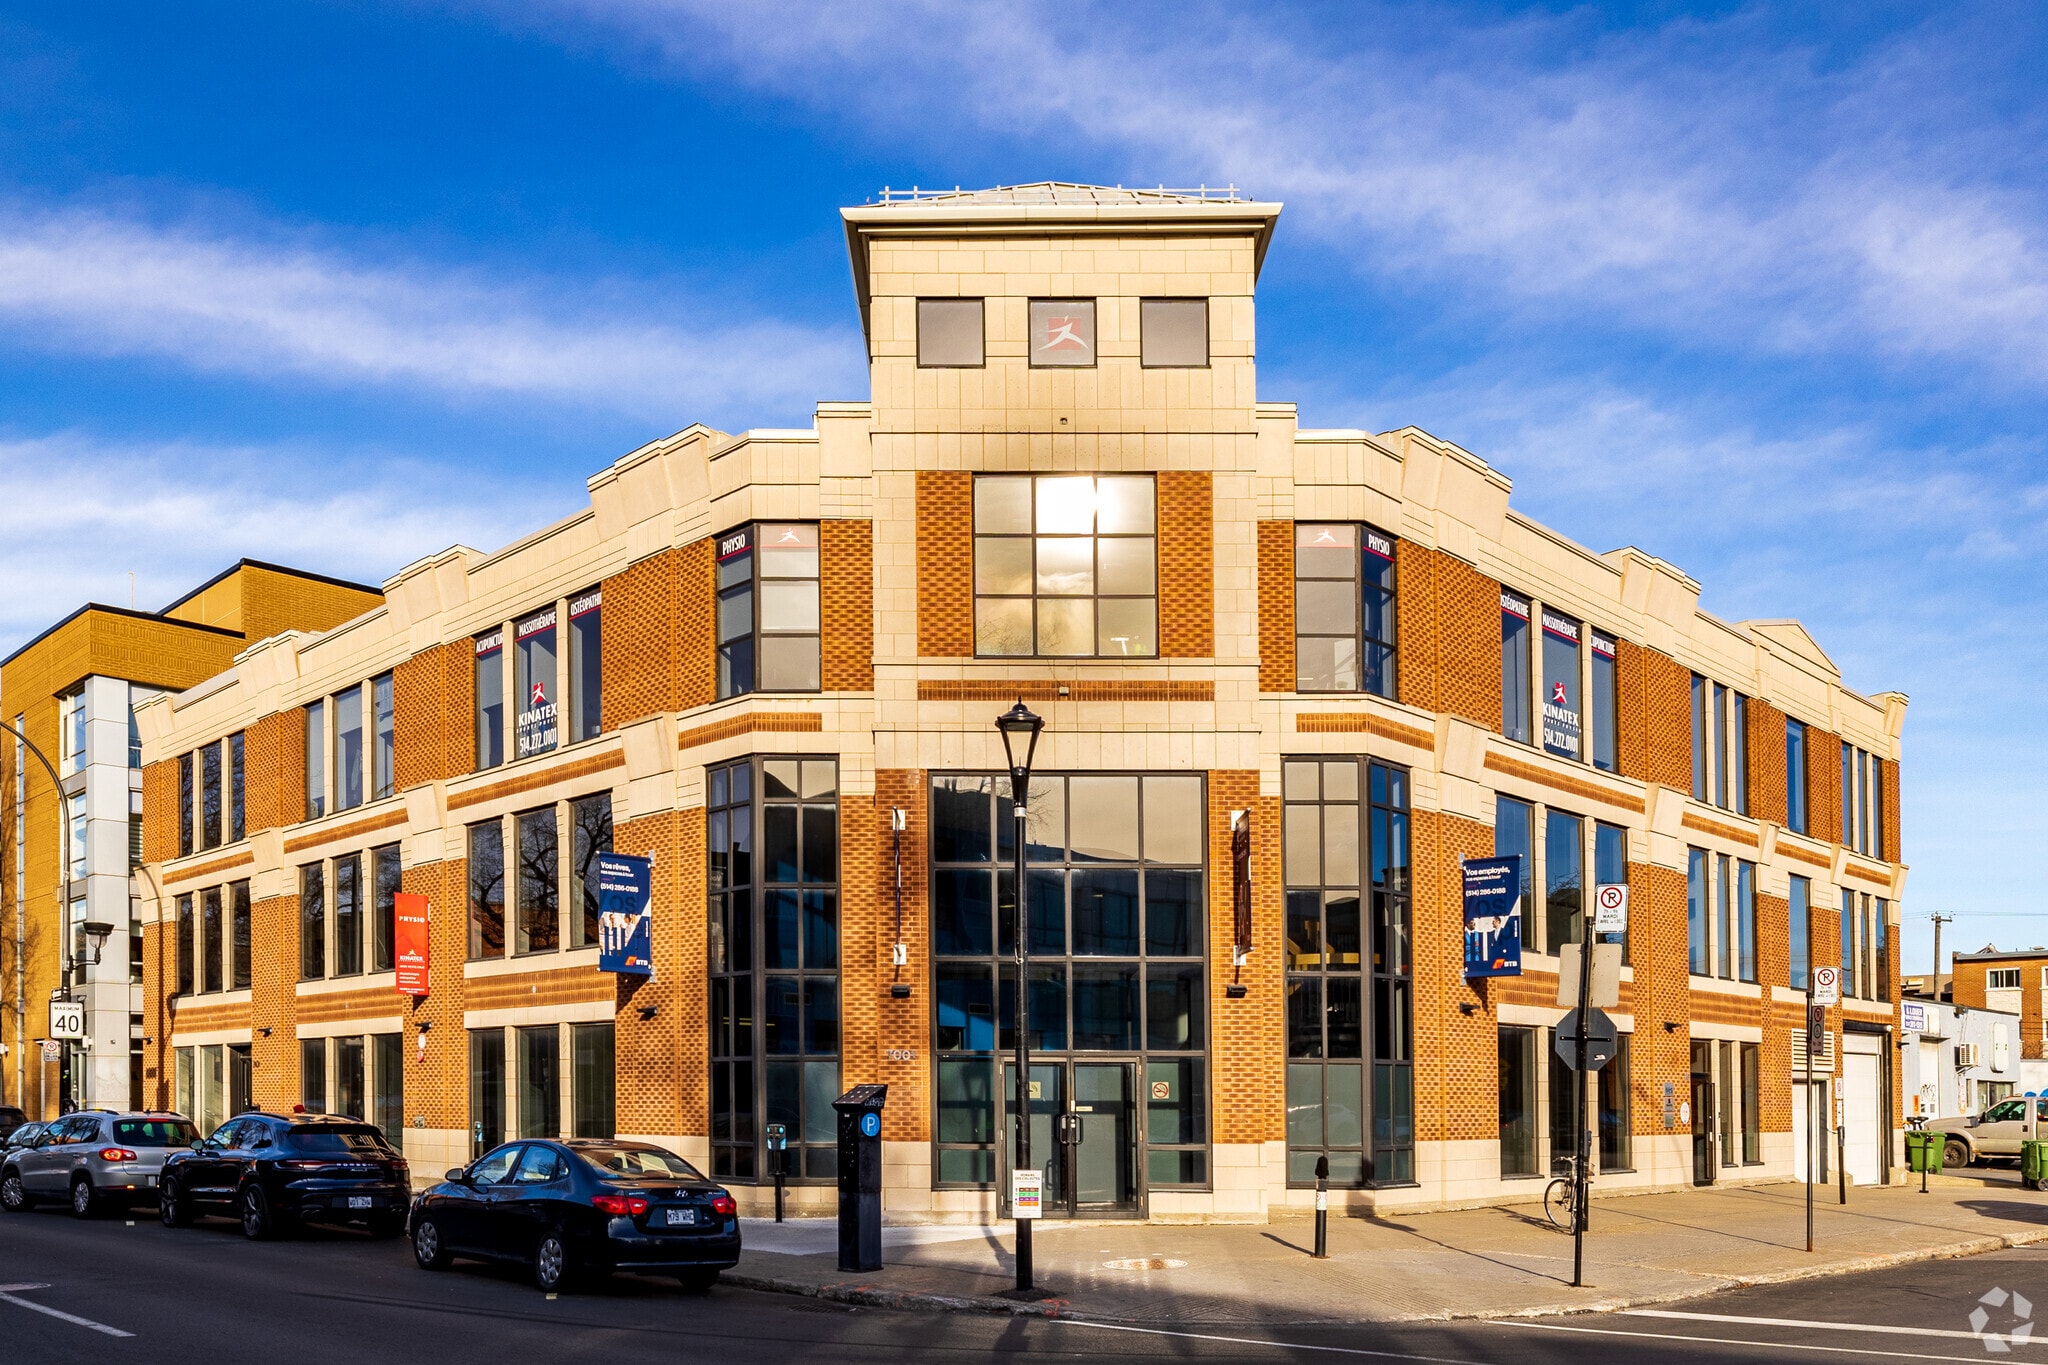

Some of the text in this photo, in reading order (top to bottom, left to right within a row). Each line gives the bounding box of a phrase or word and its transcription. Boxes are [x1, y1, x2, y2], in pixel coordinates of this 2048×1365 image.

[722, 534, 746, 556] PHYSIO
[1368, 534, 1390, 556] PHYSIO
[518, 611, 556, 637] MASSOTHÉRAPIE
[1542, 612, 1577, 638] MASSOTHÉRAPIE
[518, 702, 557, 726] KINATEX
[1542, 702, 1578, 726] KINATEX
[520, 728, 556, 754] 514.272.0101
[1544, 728, 1578, 753] 514.272.0101
[600, 861, 612, 870] Vos
[55, 1015, 79, 1032] 40
[867, 1117, 875, 1132] P
